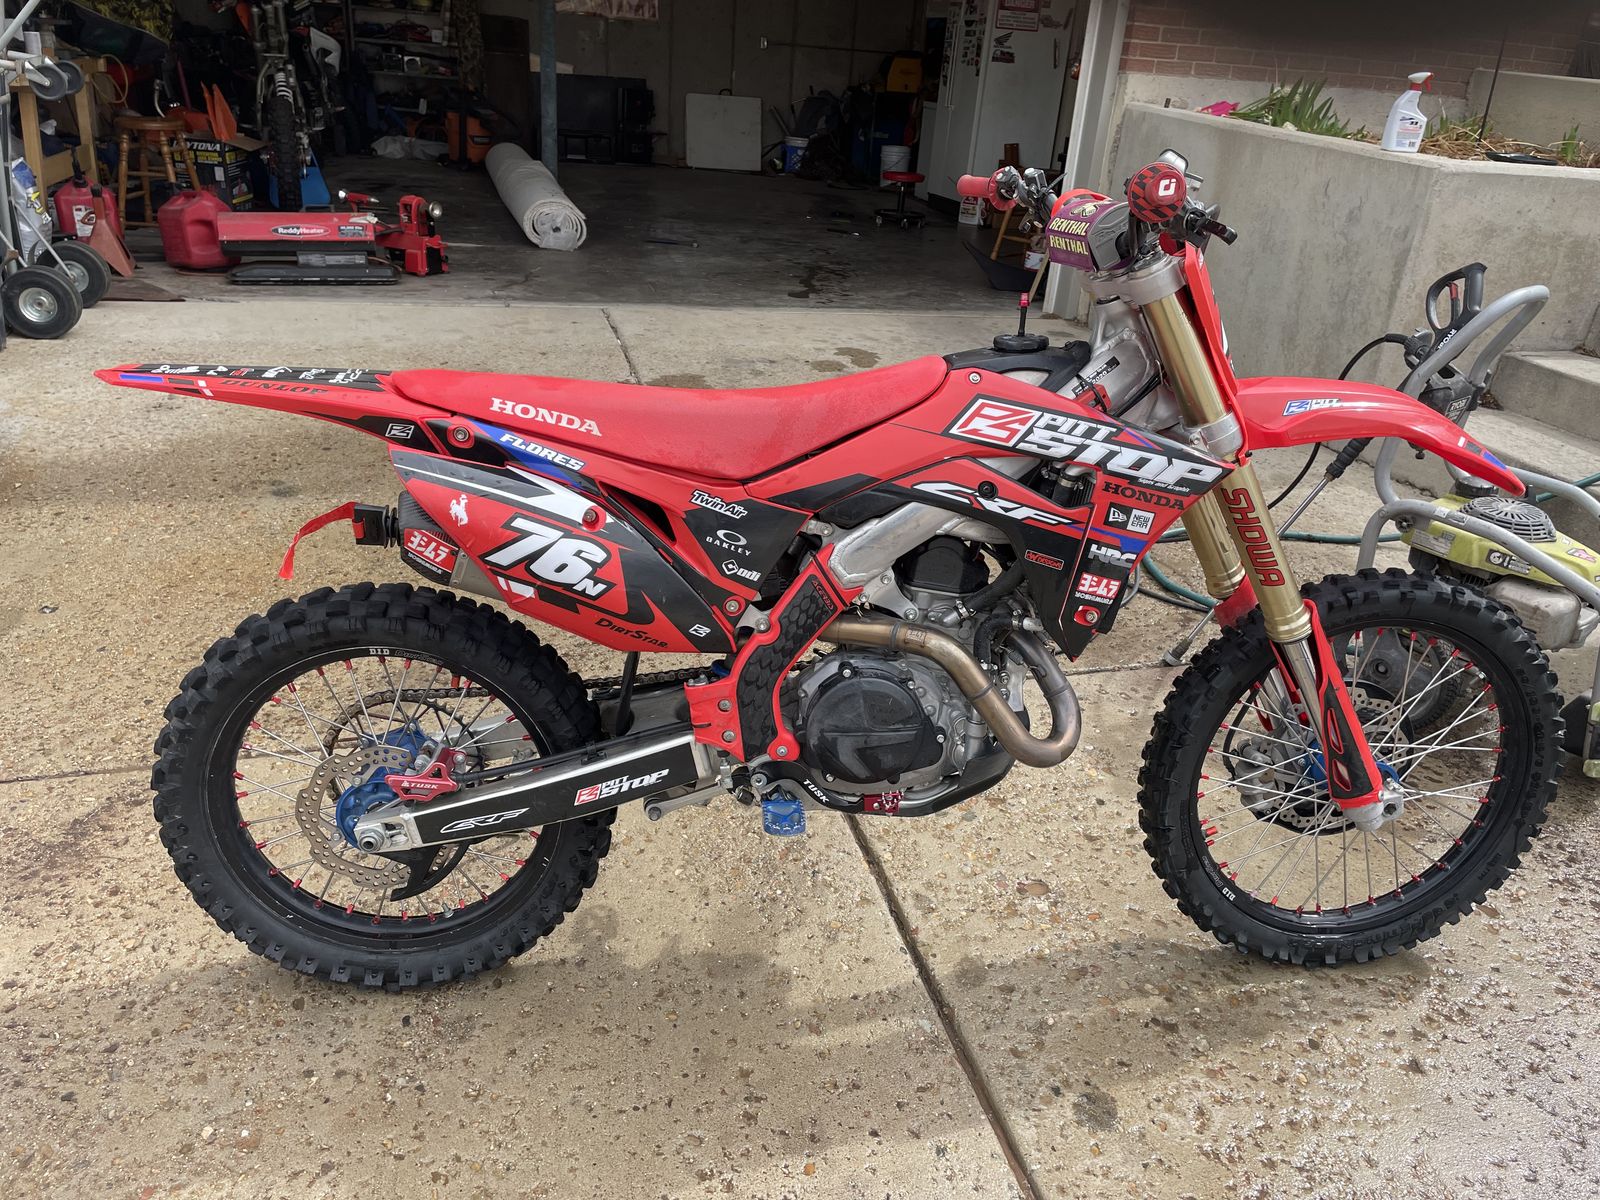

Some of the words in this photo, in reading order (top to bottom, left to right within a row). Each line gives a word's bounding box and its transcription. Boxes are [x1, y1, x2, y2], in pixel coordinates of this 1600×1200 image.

[173, 141, 221, 152] YTONA
[278, 227, 324, 236] ReddyHeater
[1049, 217, 1090, 236] RENTHAL
[1050, 235, 1089, 255] RENTHAL
[218, 379, 330, 396] DUNLOP
[489, 397, 602, 437] HONDA
[1035, 412, 1118, 442] PITT
[500, 433, 585, 471] FLORES
[1015, 425, 1223, 484] STOP
[1102, 481, 1185, 511] HONDA
[1130, 520, 1149, 530] ERA
[1133, 513, 1151, 525] NEW
[705, 536, 752, 557] OAKLEY
[1220, 487, 1286, 586] SHOWA
[483, 516, 608, 585] 76
[572, 577, 608, 597] N
[1088, 543, 1138, 569] HRC
[737, 567, 762, 582] odi
[410, 782, 439, 790] TUSK
[599, 768, 669, 799] STOP
[601, 775, 630, 789] PITT
[803, 778, 830, 803] TUSK
